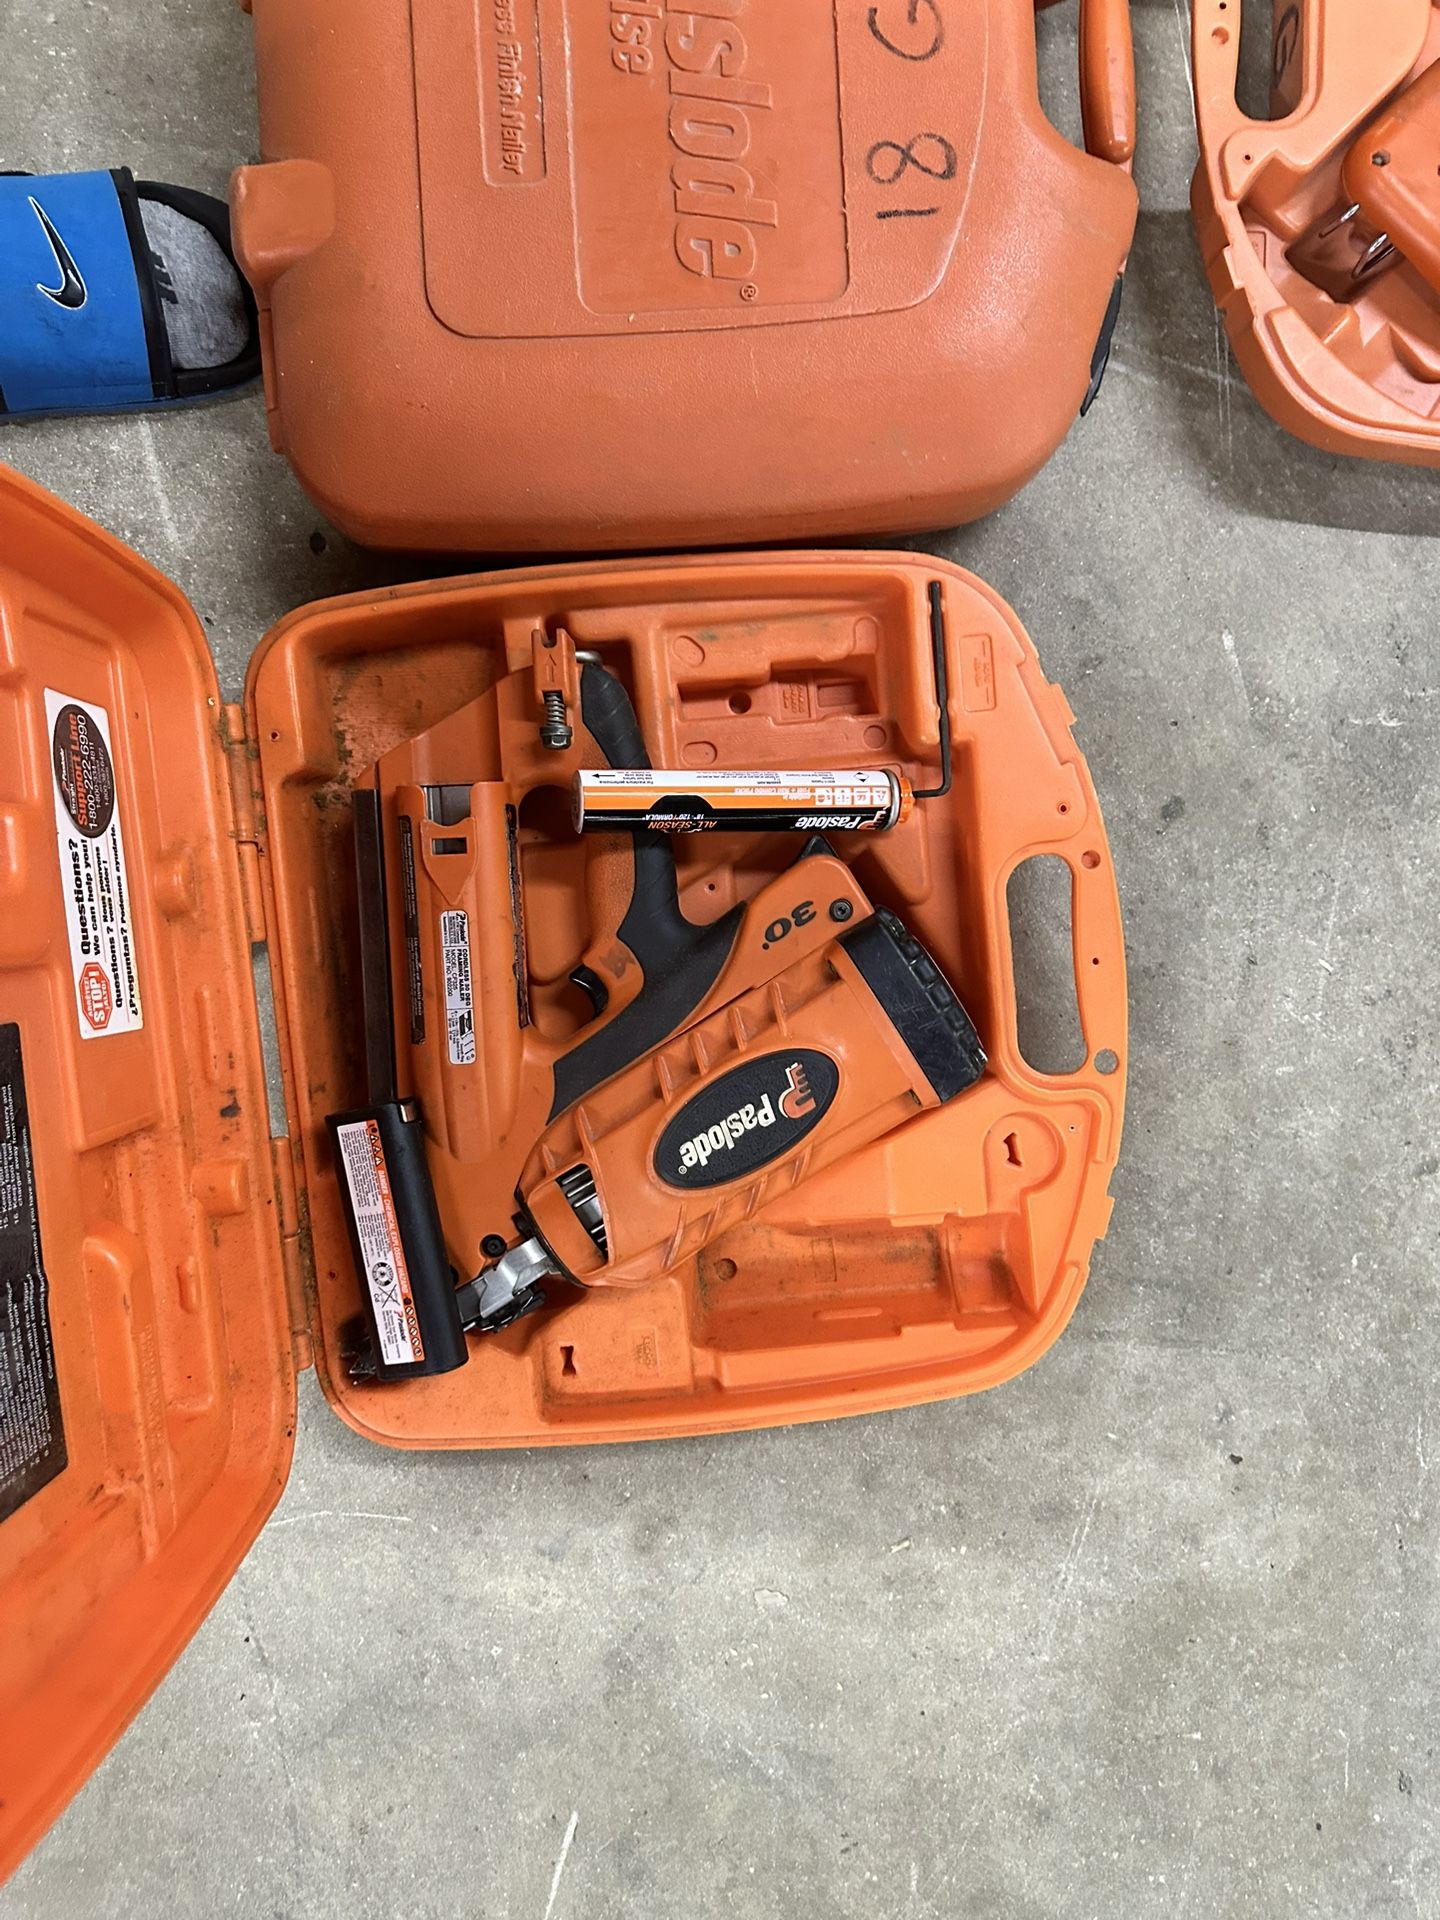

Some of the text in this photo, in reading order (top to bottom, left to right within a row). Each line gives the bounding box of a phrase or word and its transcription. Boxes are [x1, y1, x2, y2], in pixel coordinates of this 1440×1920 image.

[497, 41, 524, 106] Finish
[500, 110, 527, 176] Nailer
[69, 714, 87, 825] Support Line
[77, 714, 97, 827] 1-800-222-6990
[647, 819, 717, 830] ALL-SEASON
[794, 815, 861, 830] Paslode
[81, 839, 90, 868] you!
[68, 839, 90, 954] Questions?
[86, 873, 94, 902] help
[93, 935, 100, 955] We
[109, 937, 122, 1007] Questions
[121, 928, 138, 1015] ¿Preguntas?
[89, 971, 105, 1022] STOP!
[5, 1184, 13, 1210] being
[378, 1170, 388, 1194] DANGER
[374, 1293, 380, 1303] Cd
[32, 1322, 40, 1358] element
[18, 1344, 27, 1378] remove
